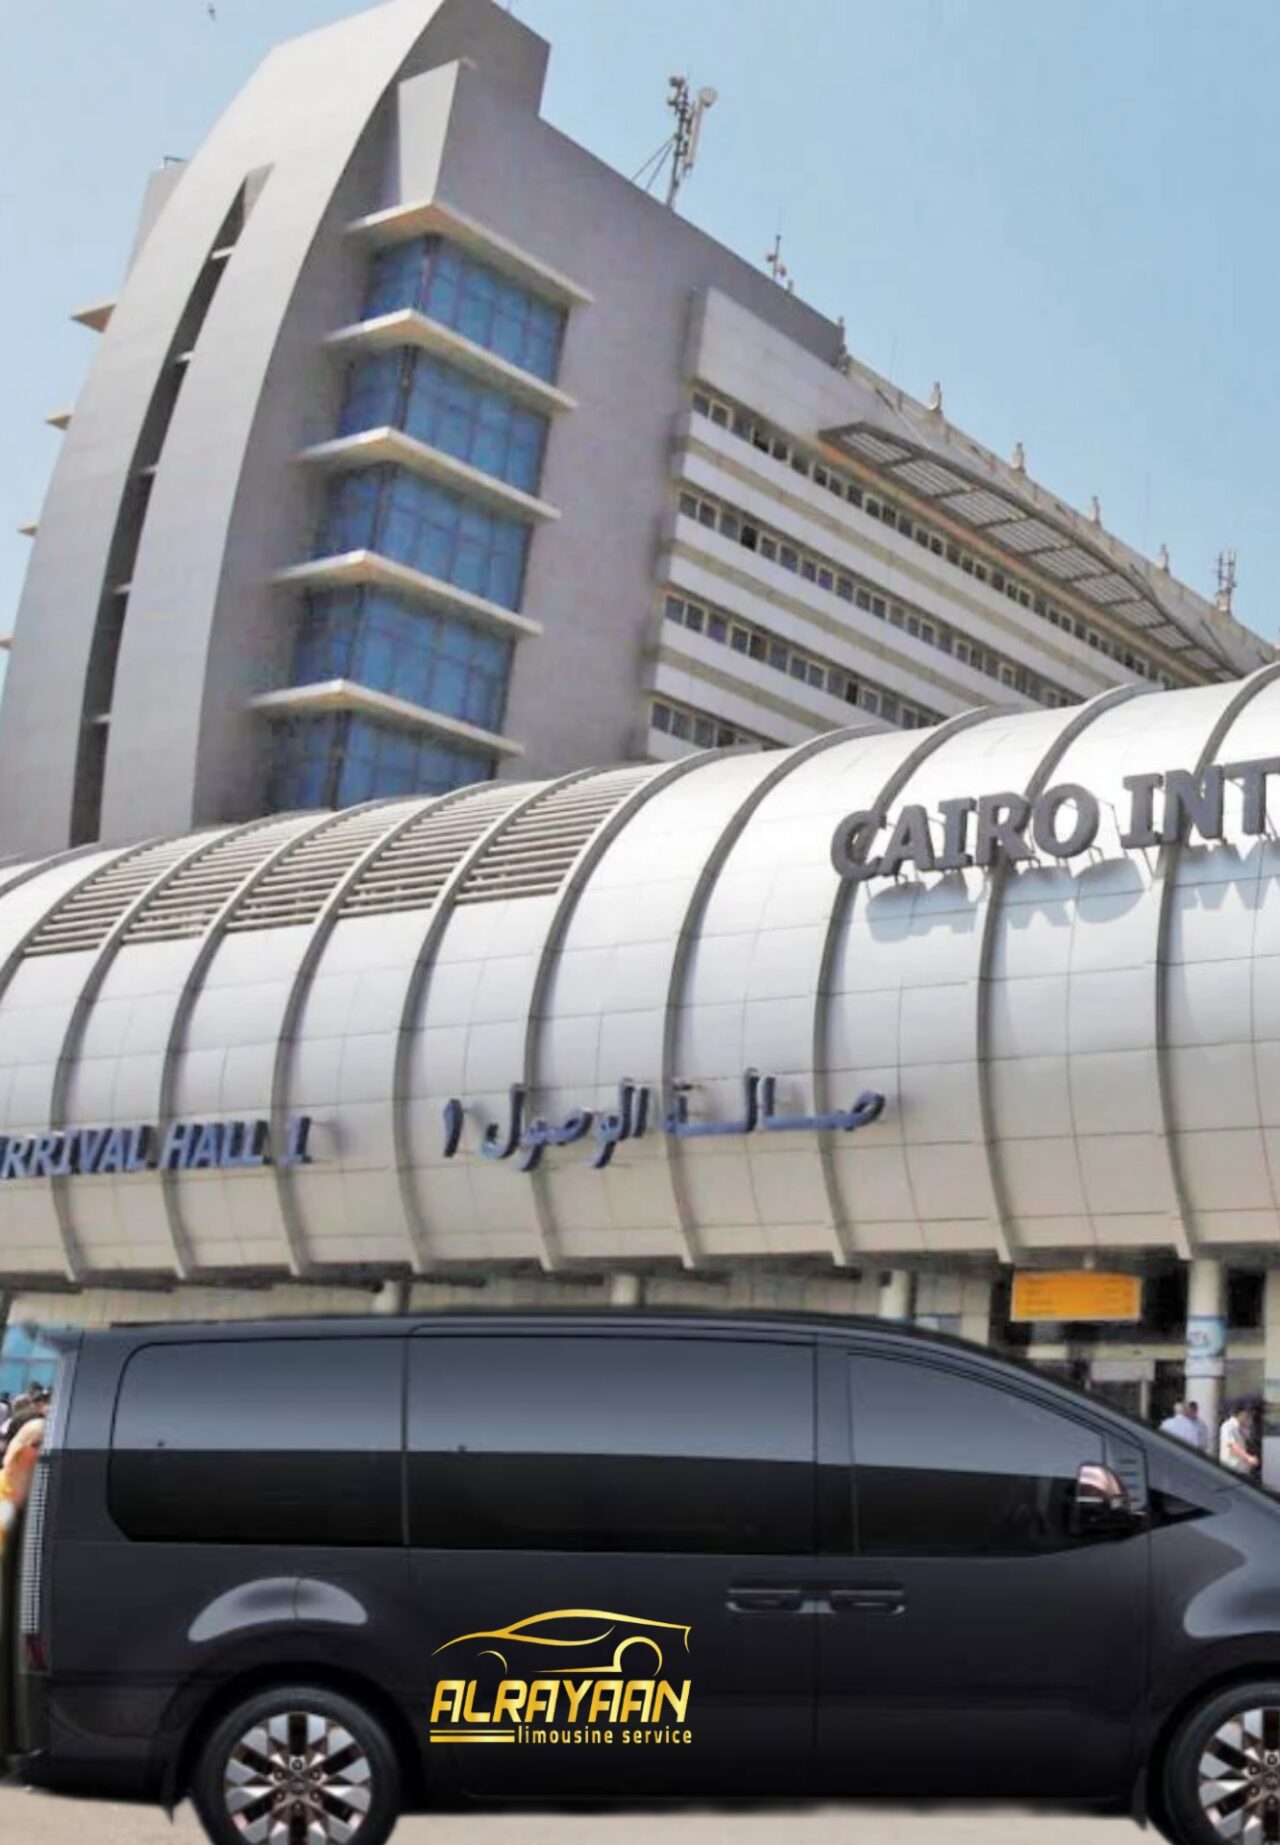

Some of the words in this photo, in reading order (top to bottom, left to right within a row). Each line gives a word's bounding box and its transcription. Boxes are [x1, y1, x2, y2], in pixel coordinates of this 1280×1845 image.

[831, 783, 1100, 881] CAIRO
[159, 1120, 272, 1169] HALL
[429, 1679, 692, 1723] ALRAYAAN
[518, 1725, 613, 1744] limousine
[622, 1726, 693, 1744] service
